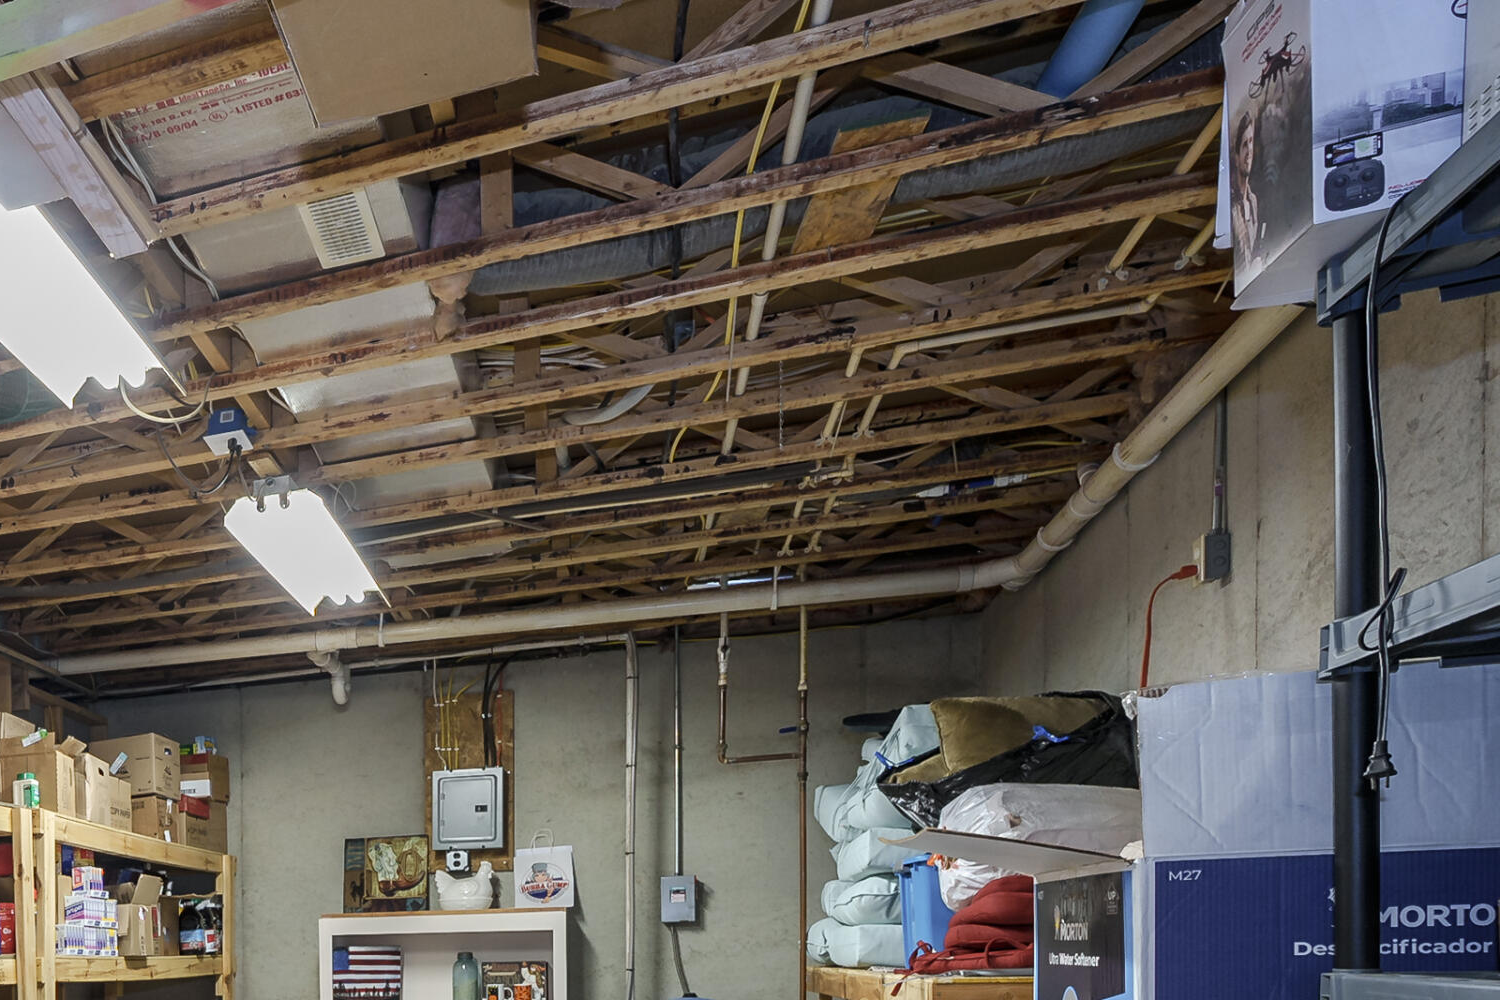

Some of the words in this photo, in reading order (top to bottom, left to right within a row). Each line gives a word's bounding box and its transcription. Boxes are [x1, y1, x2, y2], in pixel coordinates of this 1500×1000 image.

[258, 63, 291, 78] IDEAL
[235, 97, 273, 115] LISTED
[1168, 869, 1202, 881] M27
[1060, 919, 1089, 942] MORTON
[1074, 952, 1100, 967] Softener
